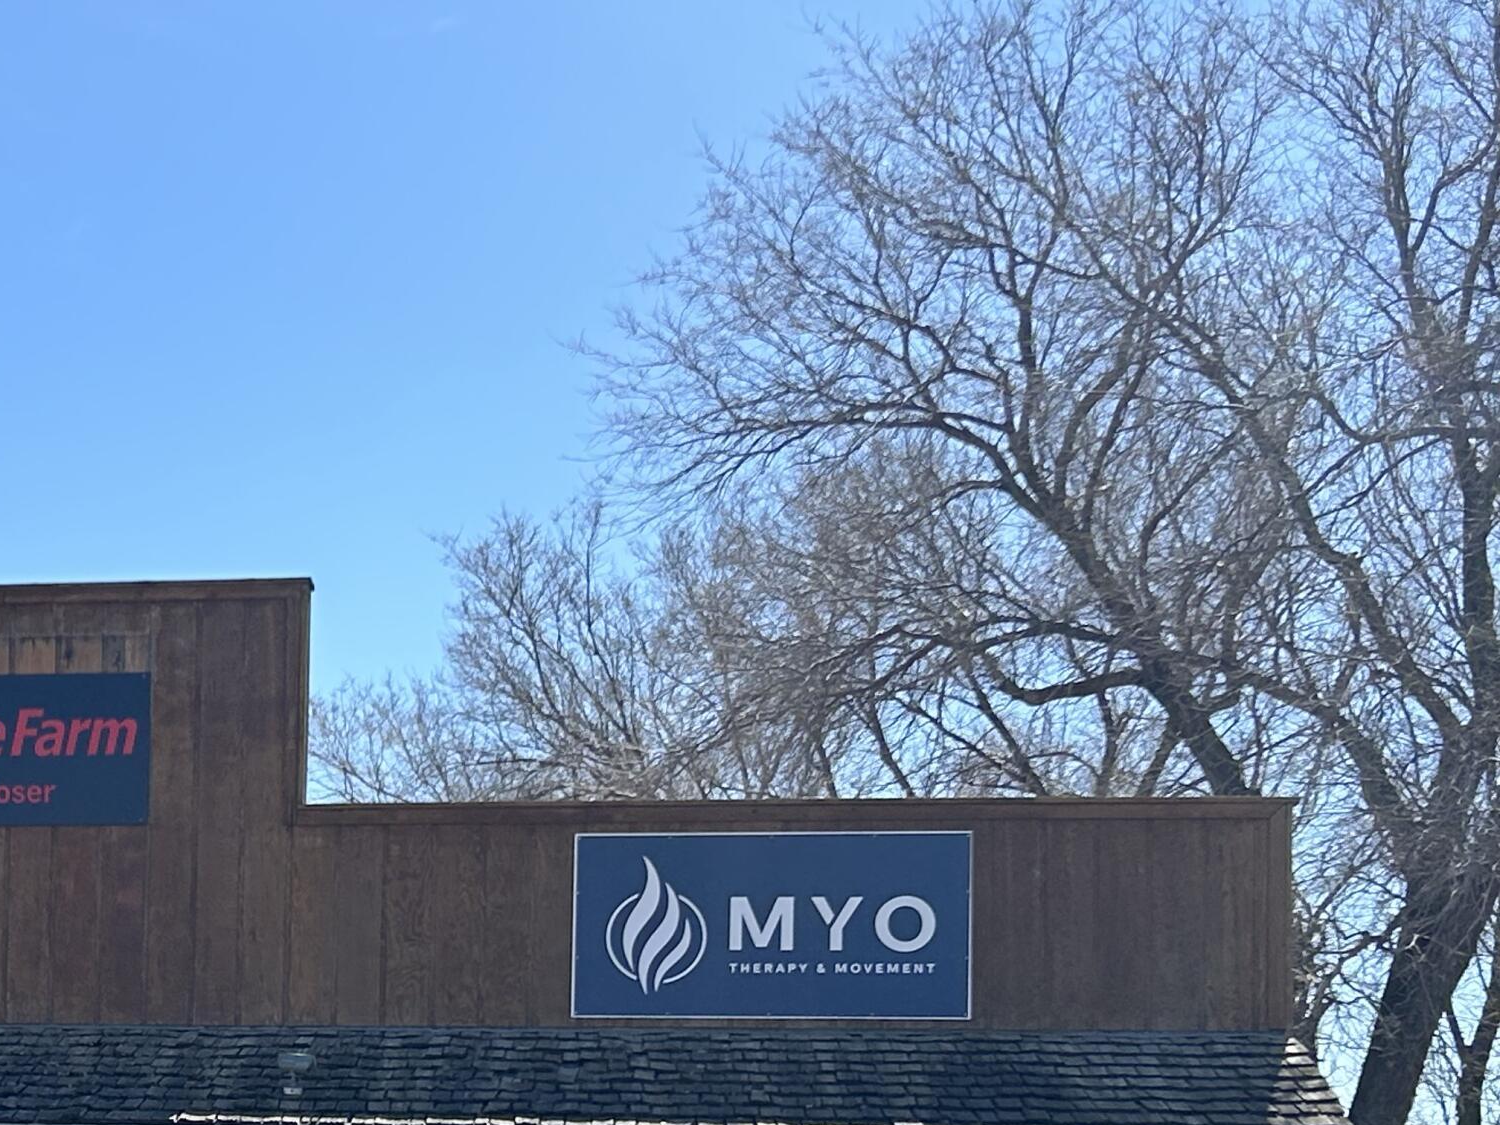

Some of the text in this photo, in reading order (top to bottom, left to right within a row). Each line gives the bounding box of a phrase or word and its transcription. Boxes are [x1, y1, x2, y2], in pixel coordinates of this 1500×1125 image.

[728, 894, 937, 953] MYO
[729, 961, 937, 975] THERAPY & MOVEMENT
